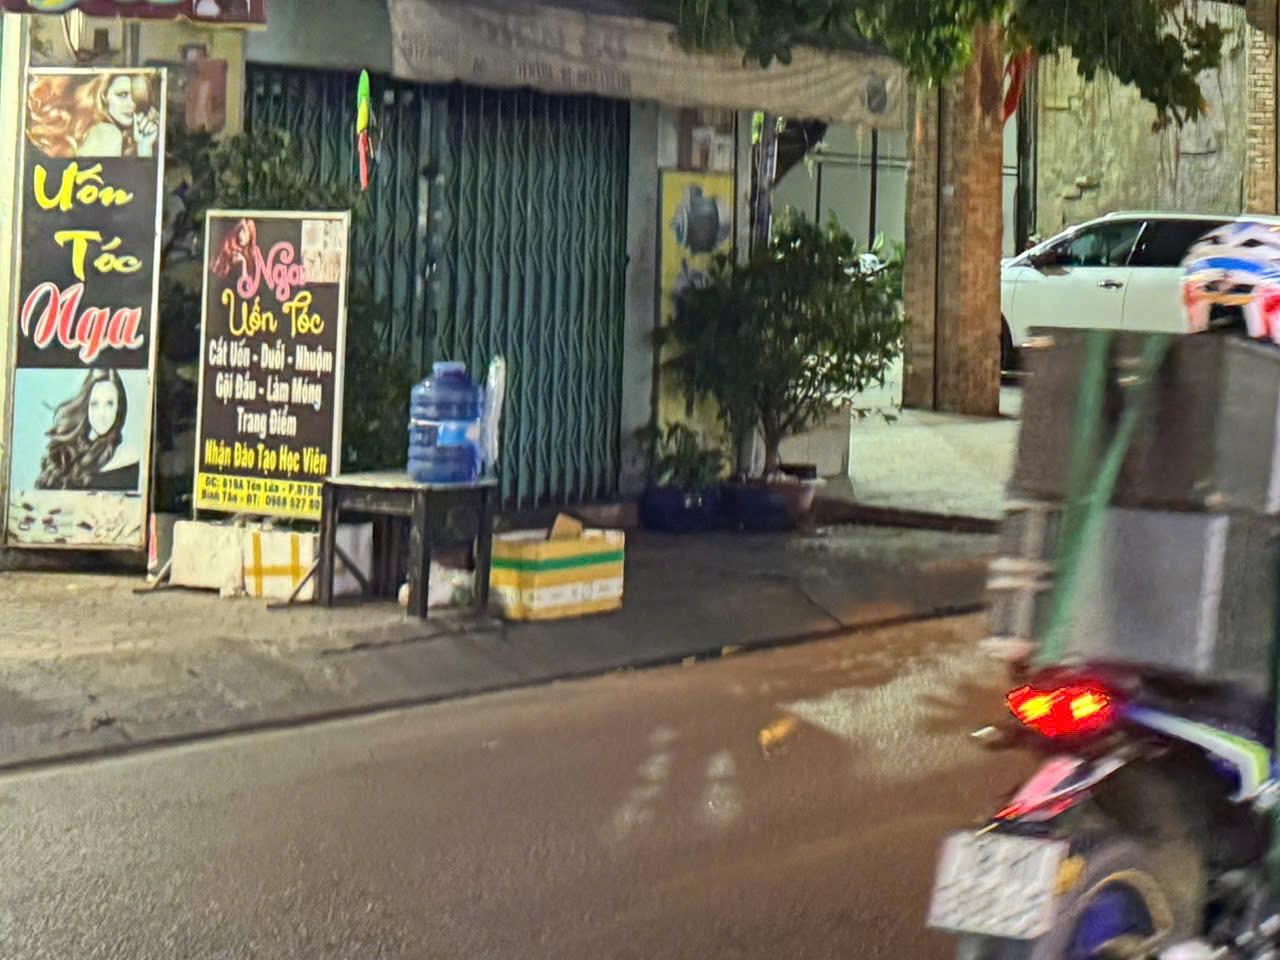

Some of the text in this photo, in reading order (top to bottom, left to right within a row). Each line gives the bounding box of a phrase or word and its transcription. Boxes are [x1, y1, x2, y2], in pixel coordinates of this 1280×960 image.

[33, 161, 134, 212] Uốn
[54, 230, 142, 282] Tóc
[237, 241, 306, 302] Nga
[20, 281, 144, 364] Nga
[222, 288, 325, 339] Uốn Tóc
[236, 405, 268, 440] Trang
